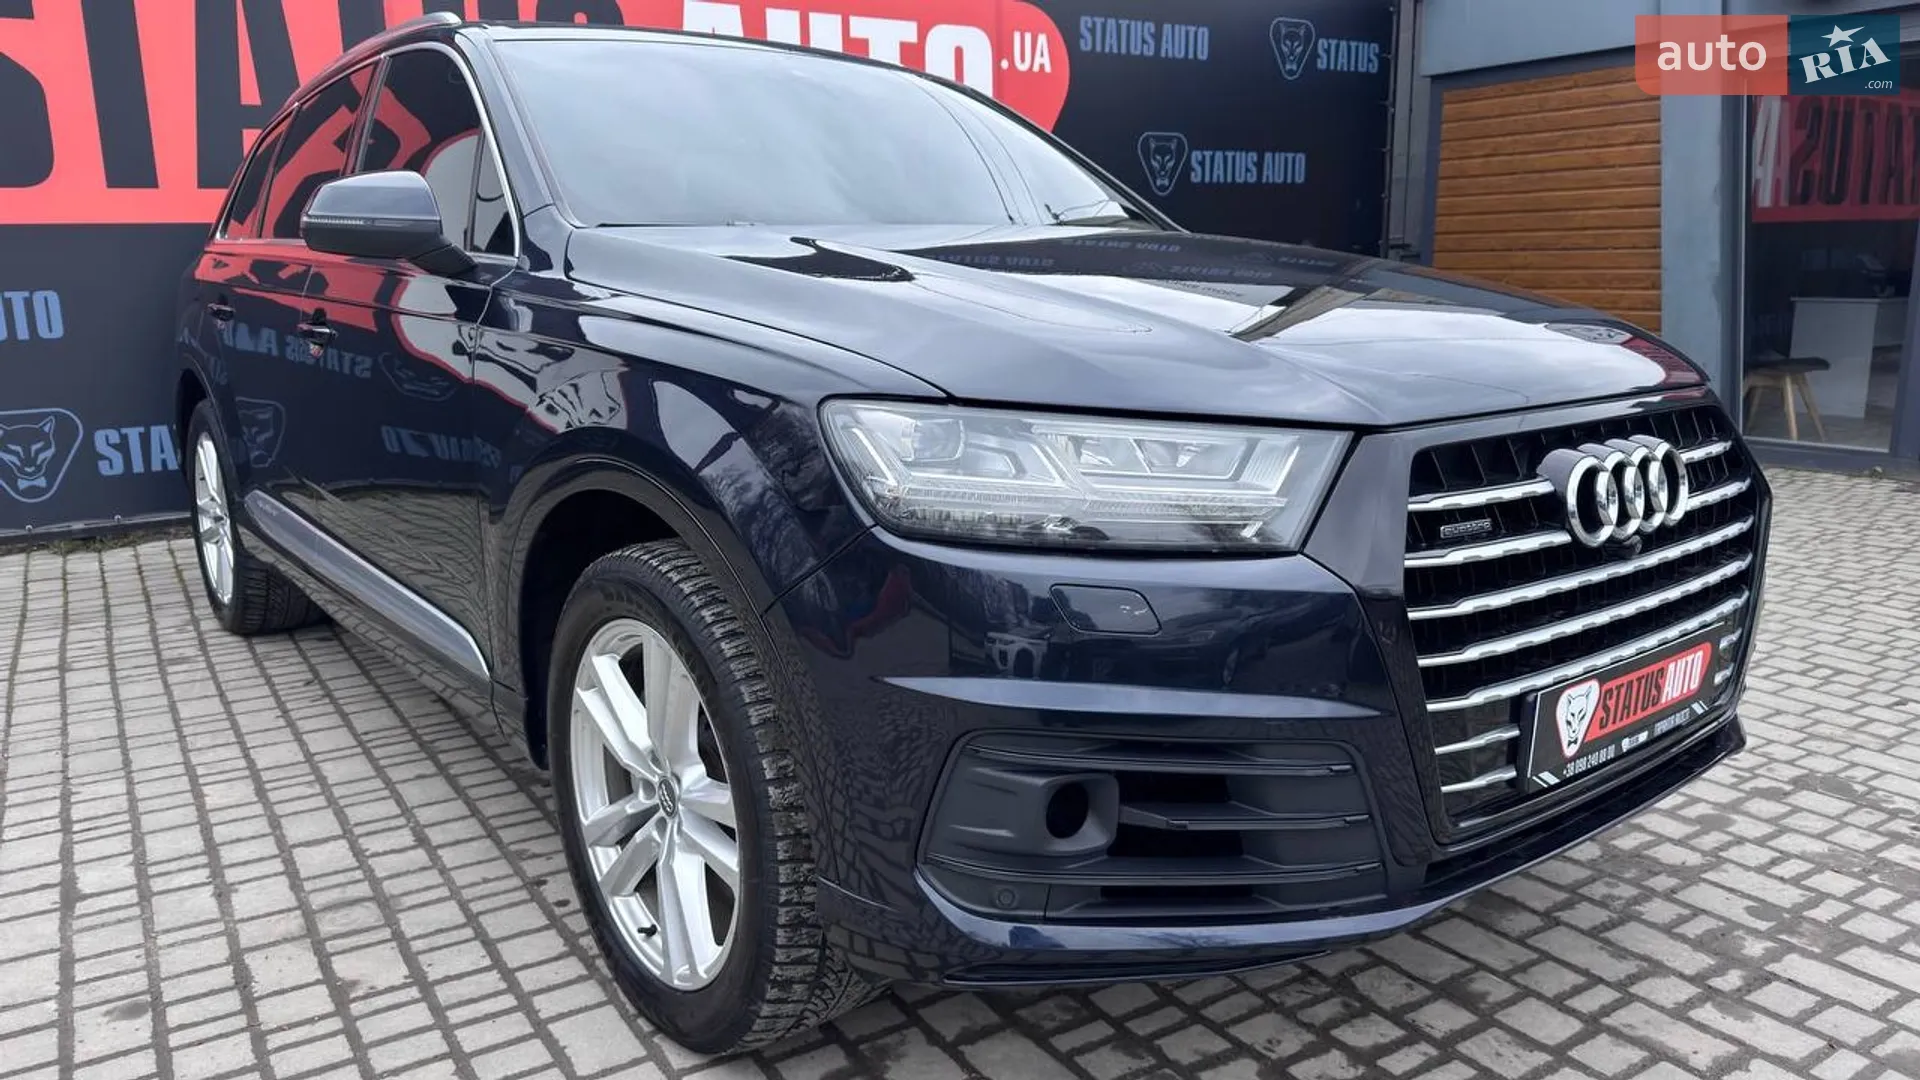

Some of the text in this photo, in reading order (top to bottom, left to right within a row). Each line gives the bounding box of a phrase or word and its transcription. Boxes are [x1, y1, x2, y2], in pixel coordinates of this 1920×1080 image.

[1079, 15, 1210, 61] STATUS AUTO
[1316, 38, 1380, 74] STATUS
[1190, 150, 1307, 185] STATUS AUTO
